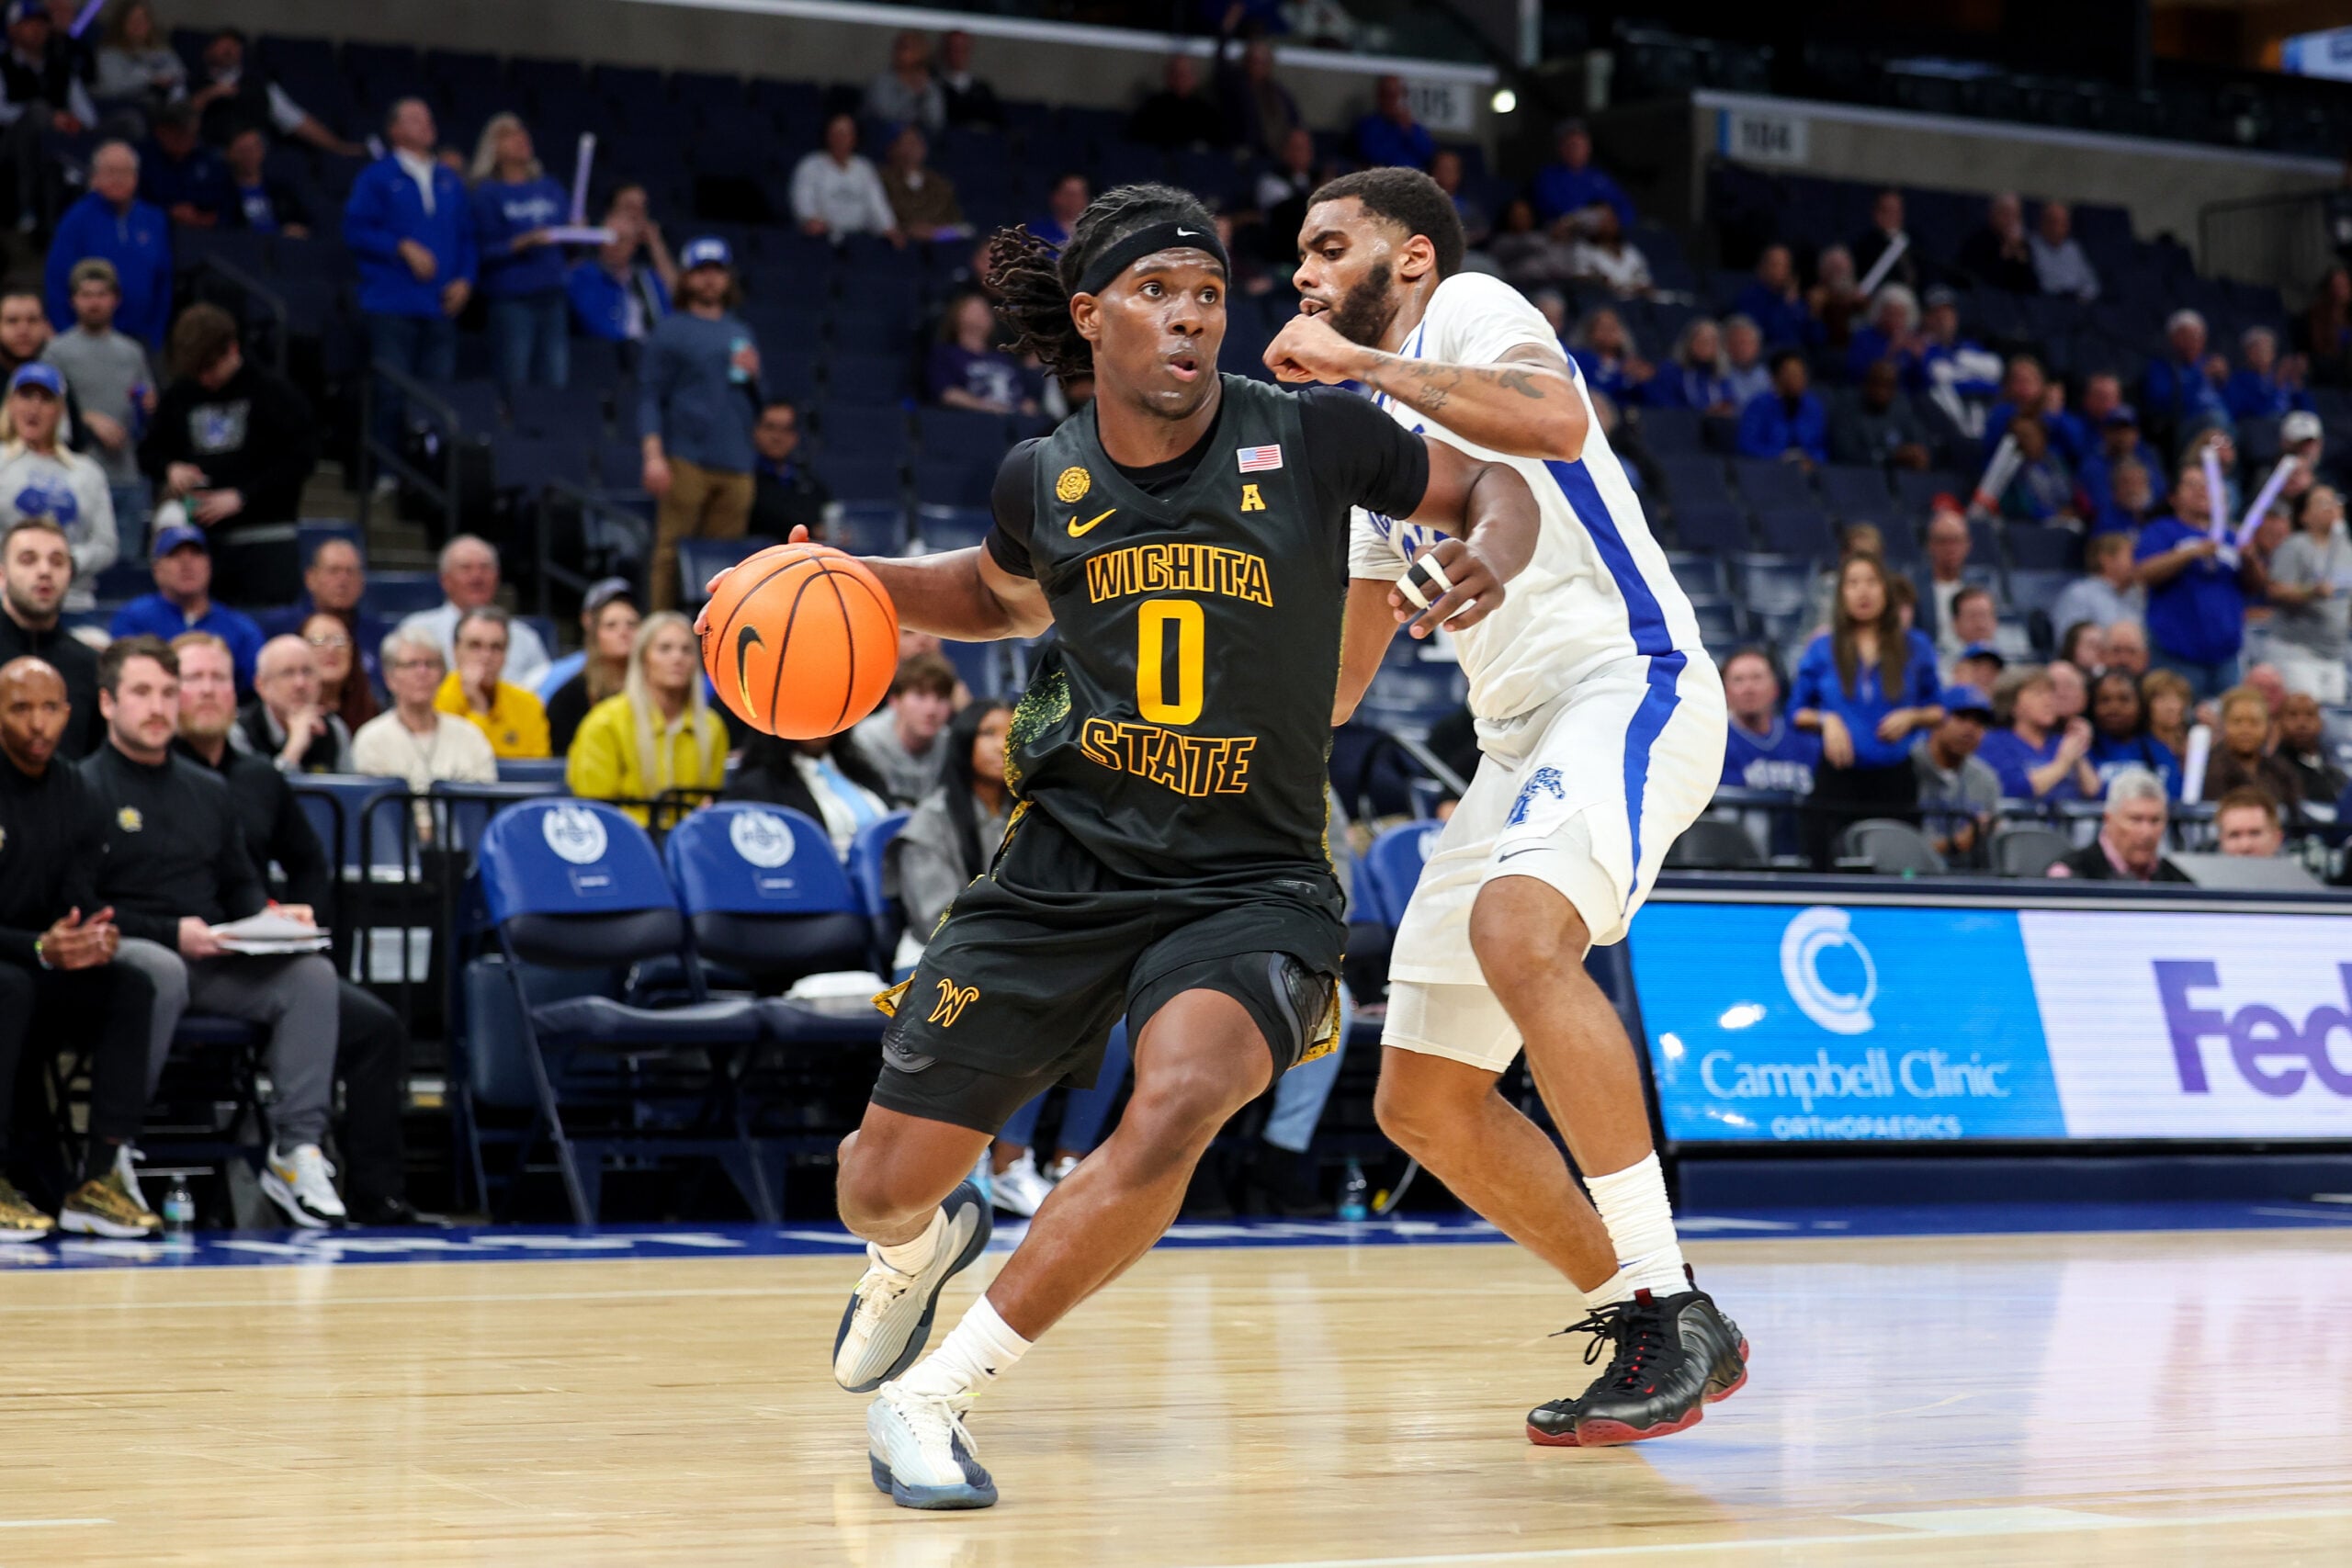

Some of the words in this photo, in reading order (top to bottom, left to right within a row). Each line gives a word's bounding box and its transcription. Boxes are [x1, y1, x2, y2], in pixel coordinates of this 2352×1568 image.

[1086, 543, 1274, 608] WICHITA
[1136, 599, 1204, 726] 0
[1080, 717, 1257, 797] STATE
[1701, 1048, 1894, 1112] Campbell
[1899, 1048, 2012, 1099] Clinic
[1770, 1115, 1962, 1141] ORTHOPAEDICS
